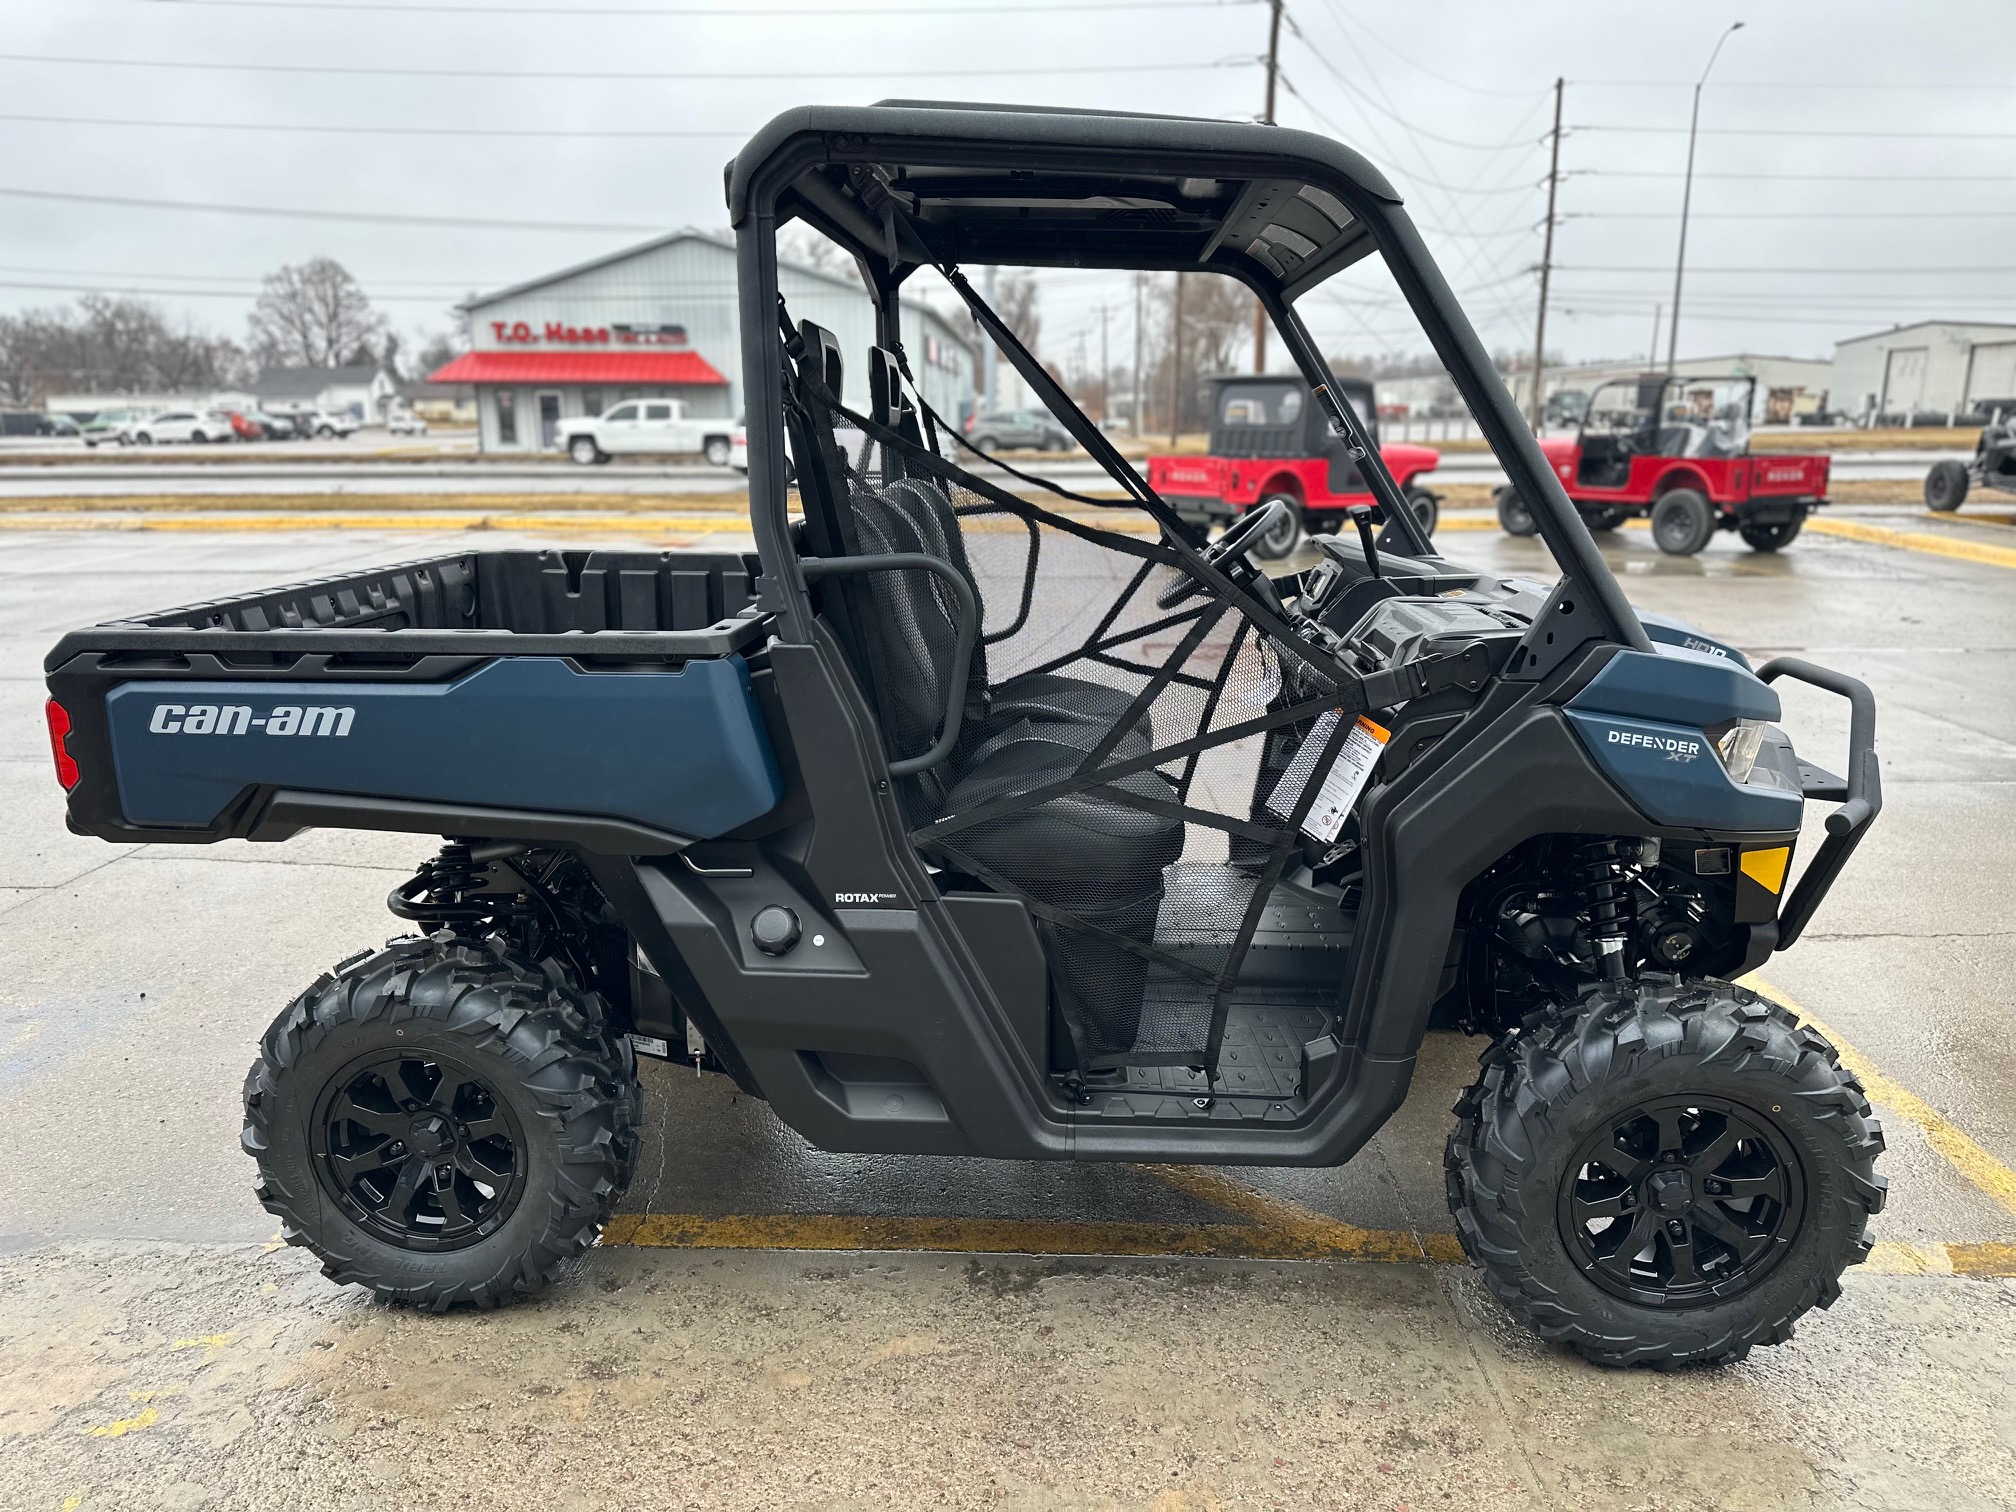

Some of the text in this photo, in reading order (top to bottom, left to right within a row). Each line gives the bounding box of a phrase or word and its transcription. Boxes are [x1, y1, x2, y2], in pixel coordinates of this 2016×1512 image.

[545, 322, 610, 344] Haas
[149, 704, 356, 737] can-am
[1607, 730, 1700, 754] DEFENDER
[1664, 752, 1698, 764] XT
[835, 893, 879, 903] ROTAX
